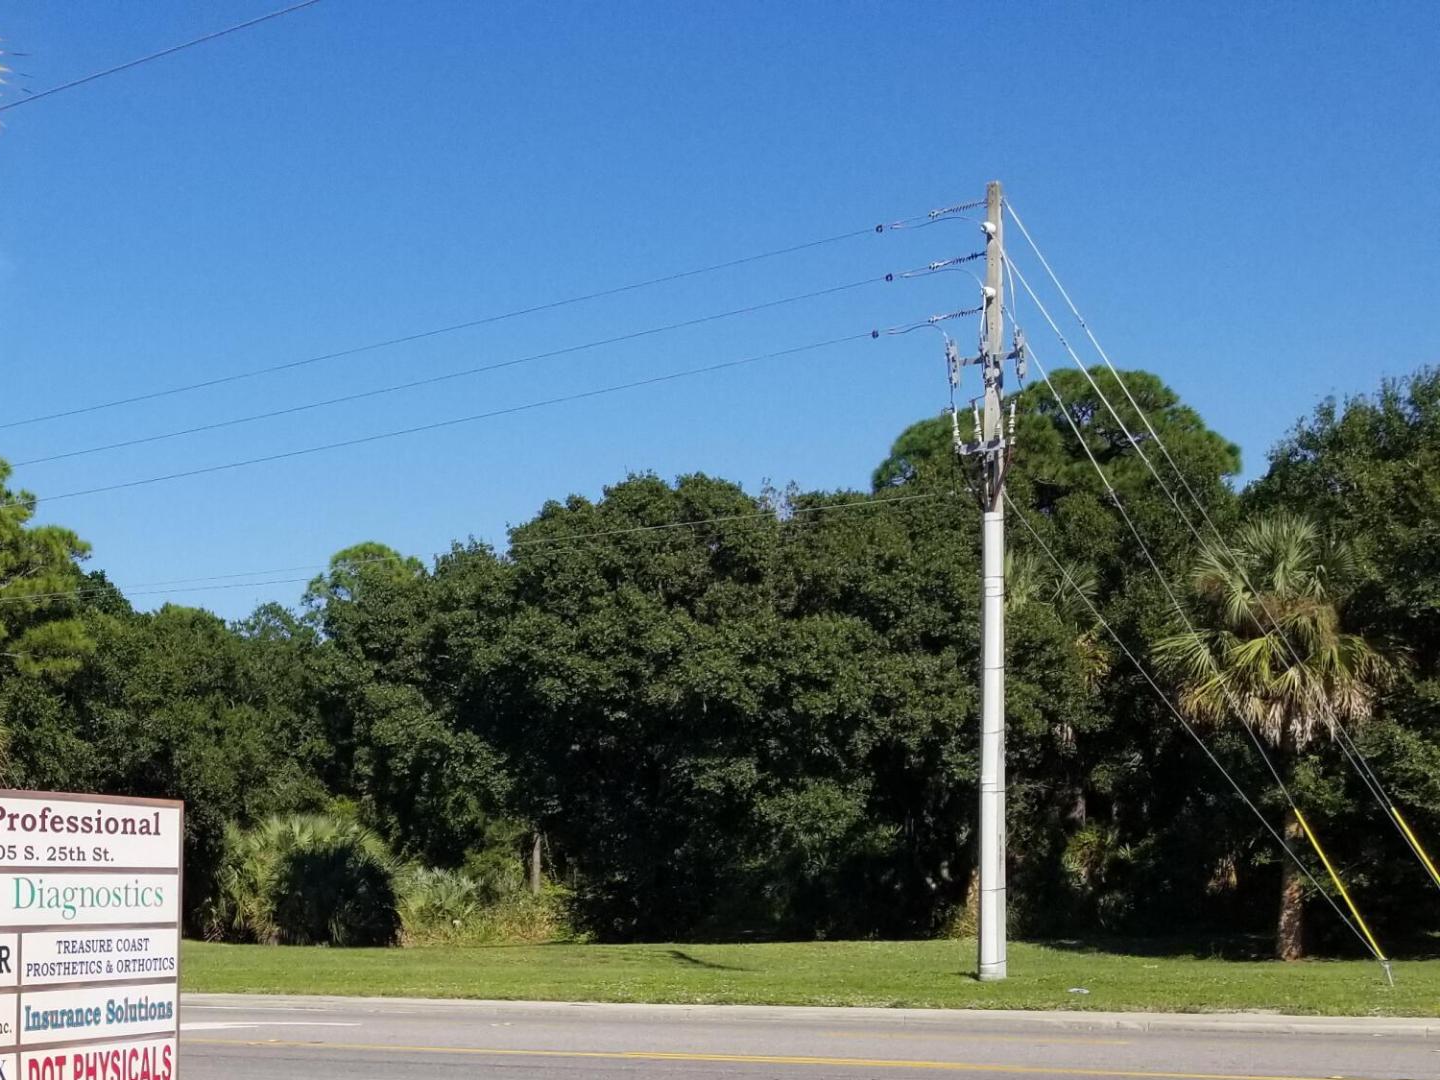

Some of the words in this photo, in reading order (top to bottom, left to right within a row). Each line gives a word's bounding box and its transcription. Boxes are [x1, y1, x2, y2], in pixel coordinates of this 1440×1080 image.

[23, 844, 40, 861] S.
[46, 845, 87, 862] 25th
[92, 846, 115, 862] St.
[12, 876, 165, 921] Diagnostics
[56, 938, 113, 955] TREASURE
[116, 937, 150, 953] COAST
[26, 960, 103, 978] PROSTHETICS
[105, 960, 114, 973] &
[116, 956, 175, 974] ORTHOTICS
[24, 1005, 101, 1032] Insurance
[105, 995, 173, 1025] Solutions
